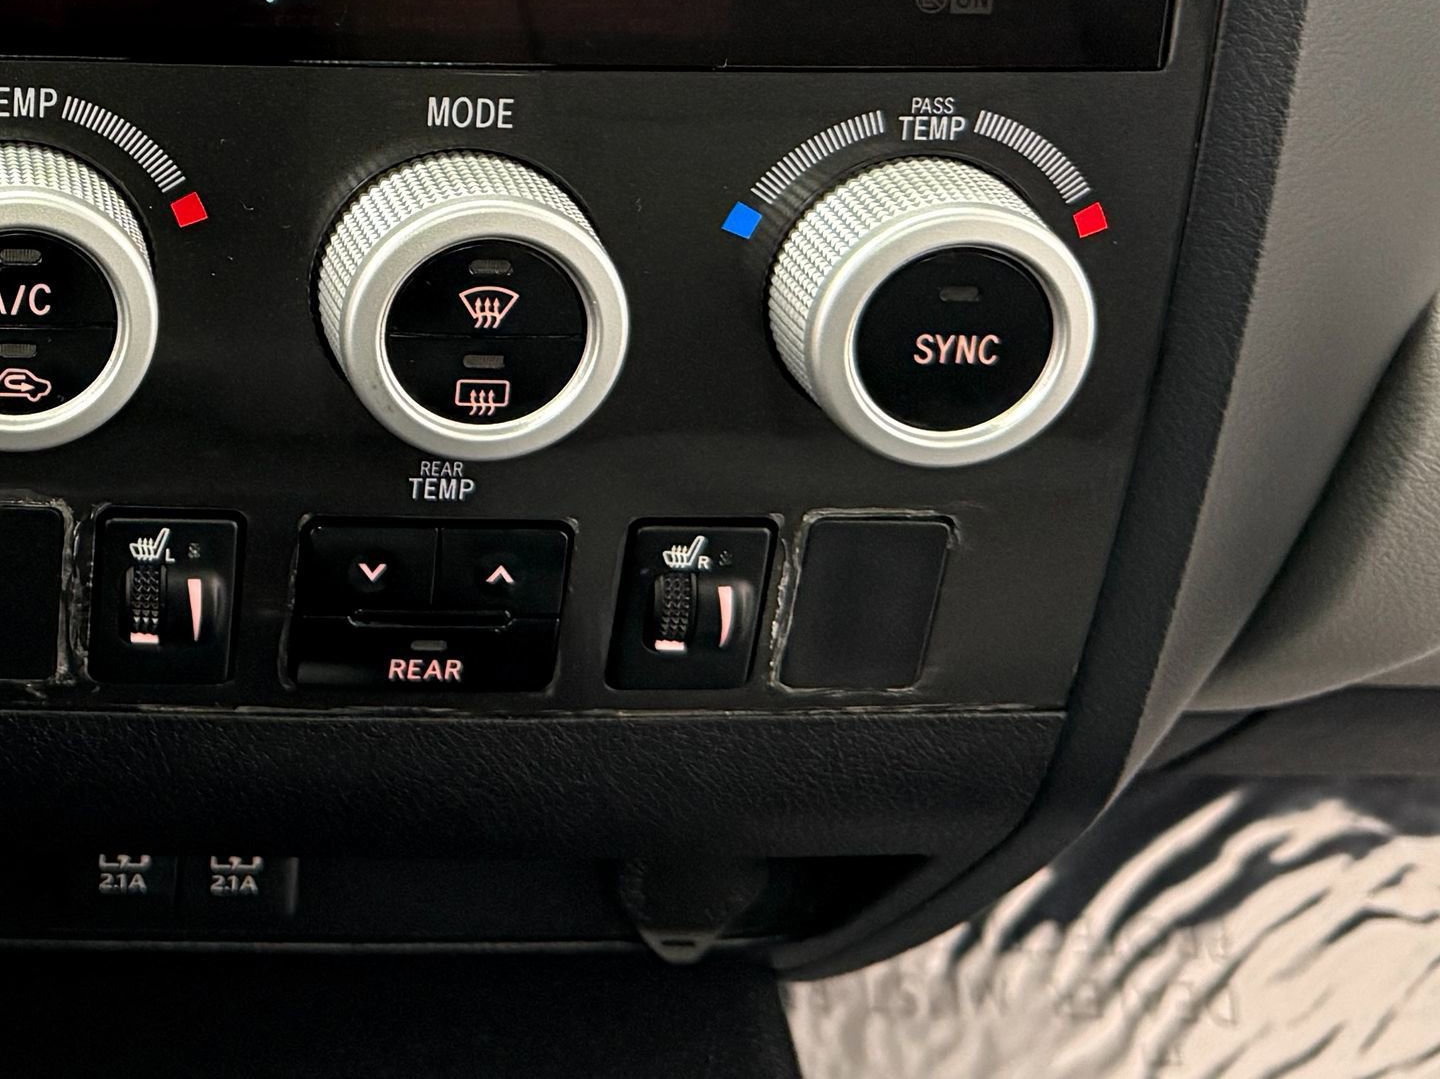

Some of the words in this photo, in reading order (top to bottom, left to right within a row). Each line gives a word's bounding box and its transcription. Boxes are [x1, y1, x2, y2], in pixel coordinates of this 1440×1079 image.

[427, 96, 515, 129] MODE
[911, 97, 955, 114] PASS
[898, 116, 966, 141] TEMP
[913, 334, 1000, 366] SYNC
[419, 460, 464, 477] REAR
[409, 477, 475, 500] TEMP
[164, 547, 177, 564] L
[697, 555, 713, 571] R
[388, 658, 462, 681] REAR
[99, 872, 148, 894] 2.1A
[210, 874, 260, 896] 2.1A
